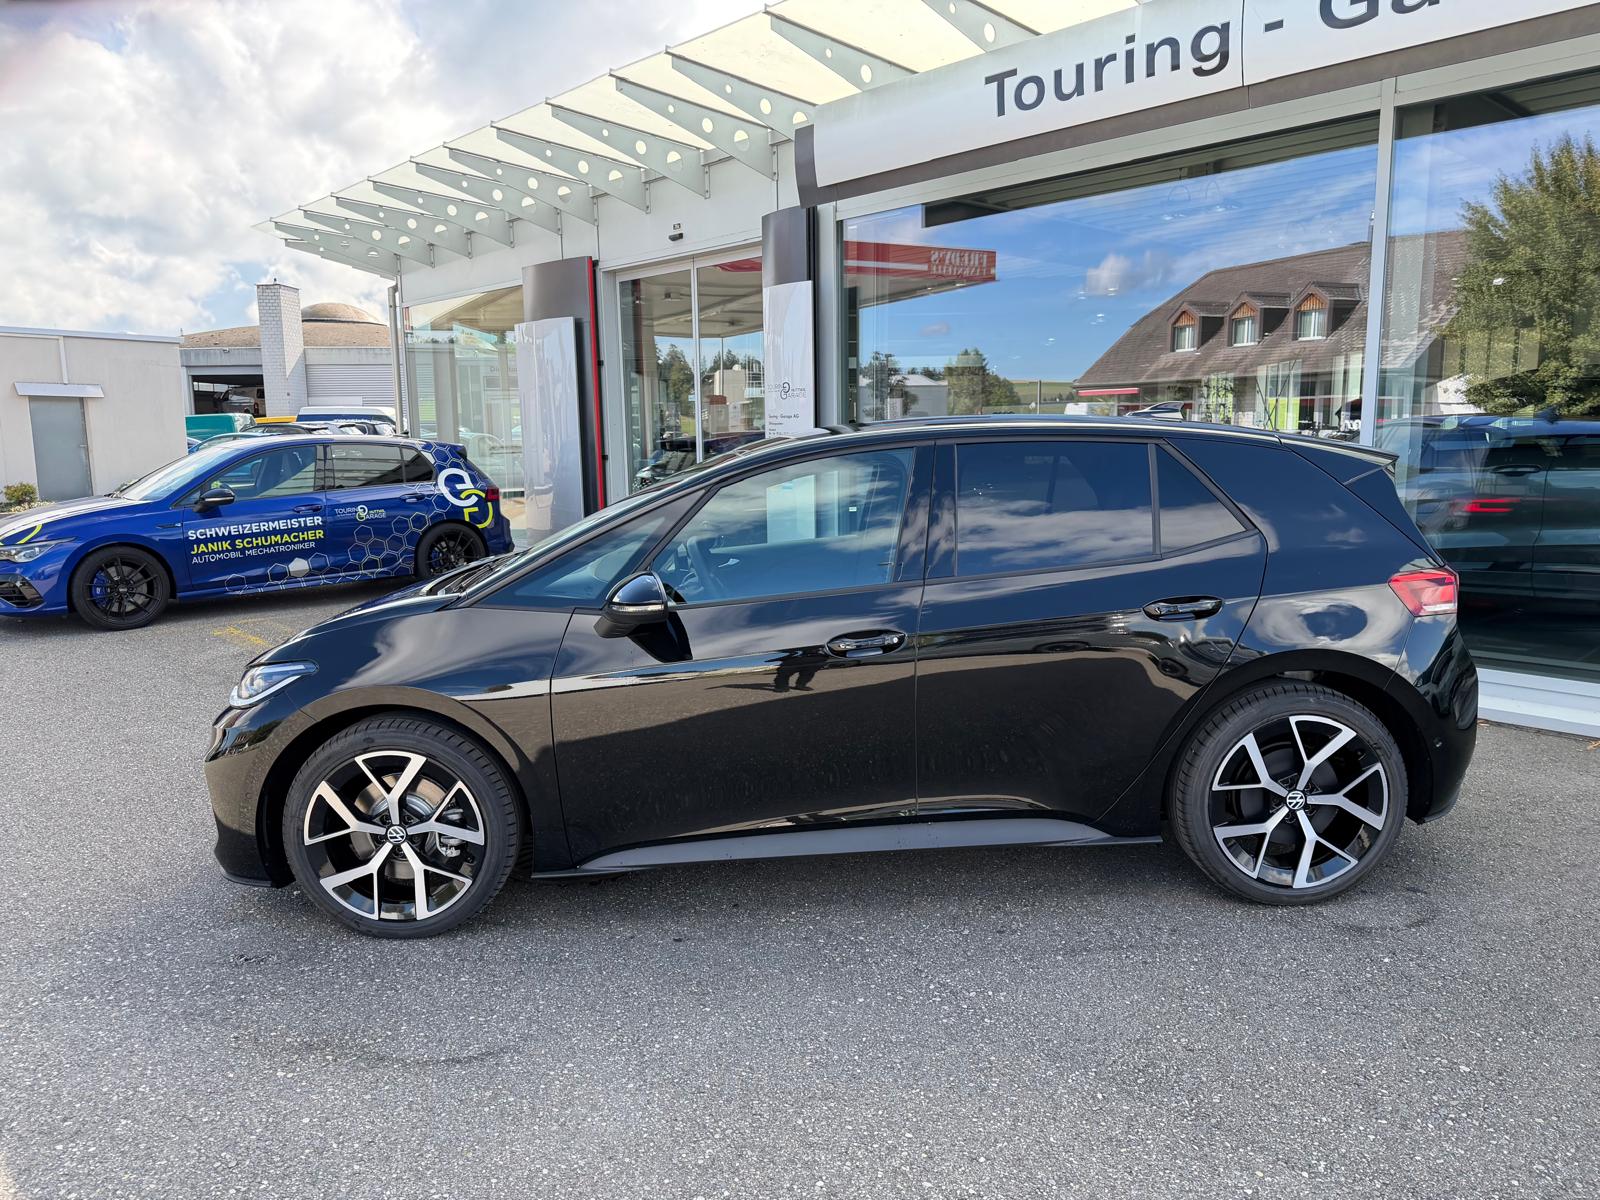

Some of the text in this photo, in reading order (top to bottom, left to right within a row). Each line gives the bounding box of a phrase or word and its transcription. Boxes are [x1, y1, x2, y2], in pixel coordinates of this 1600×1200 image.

[984, 21, 1231, 118] Touring
[187, 516, 323, 541] SCHWEIZERMEISTER
[190, 529, 325, 555] JANIK SCHUMACHER
[191, 541, 316, 565] AUTOMOBIL MECHATRONIKER
